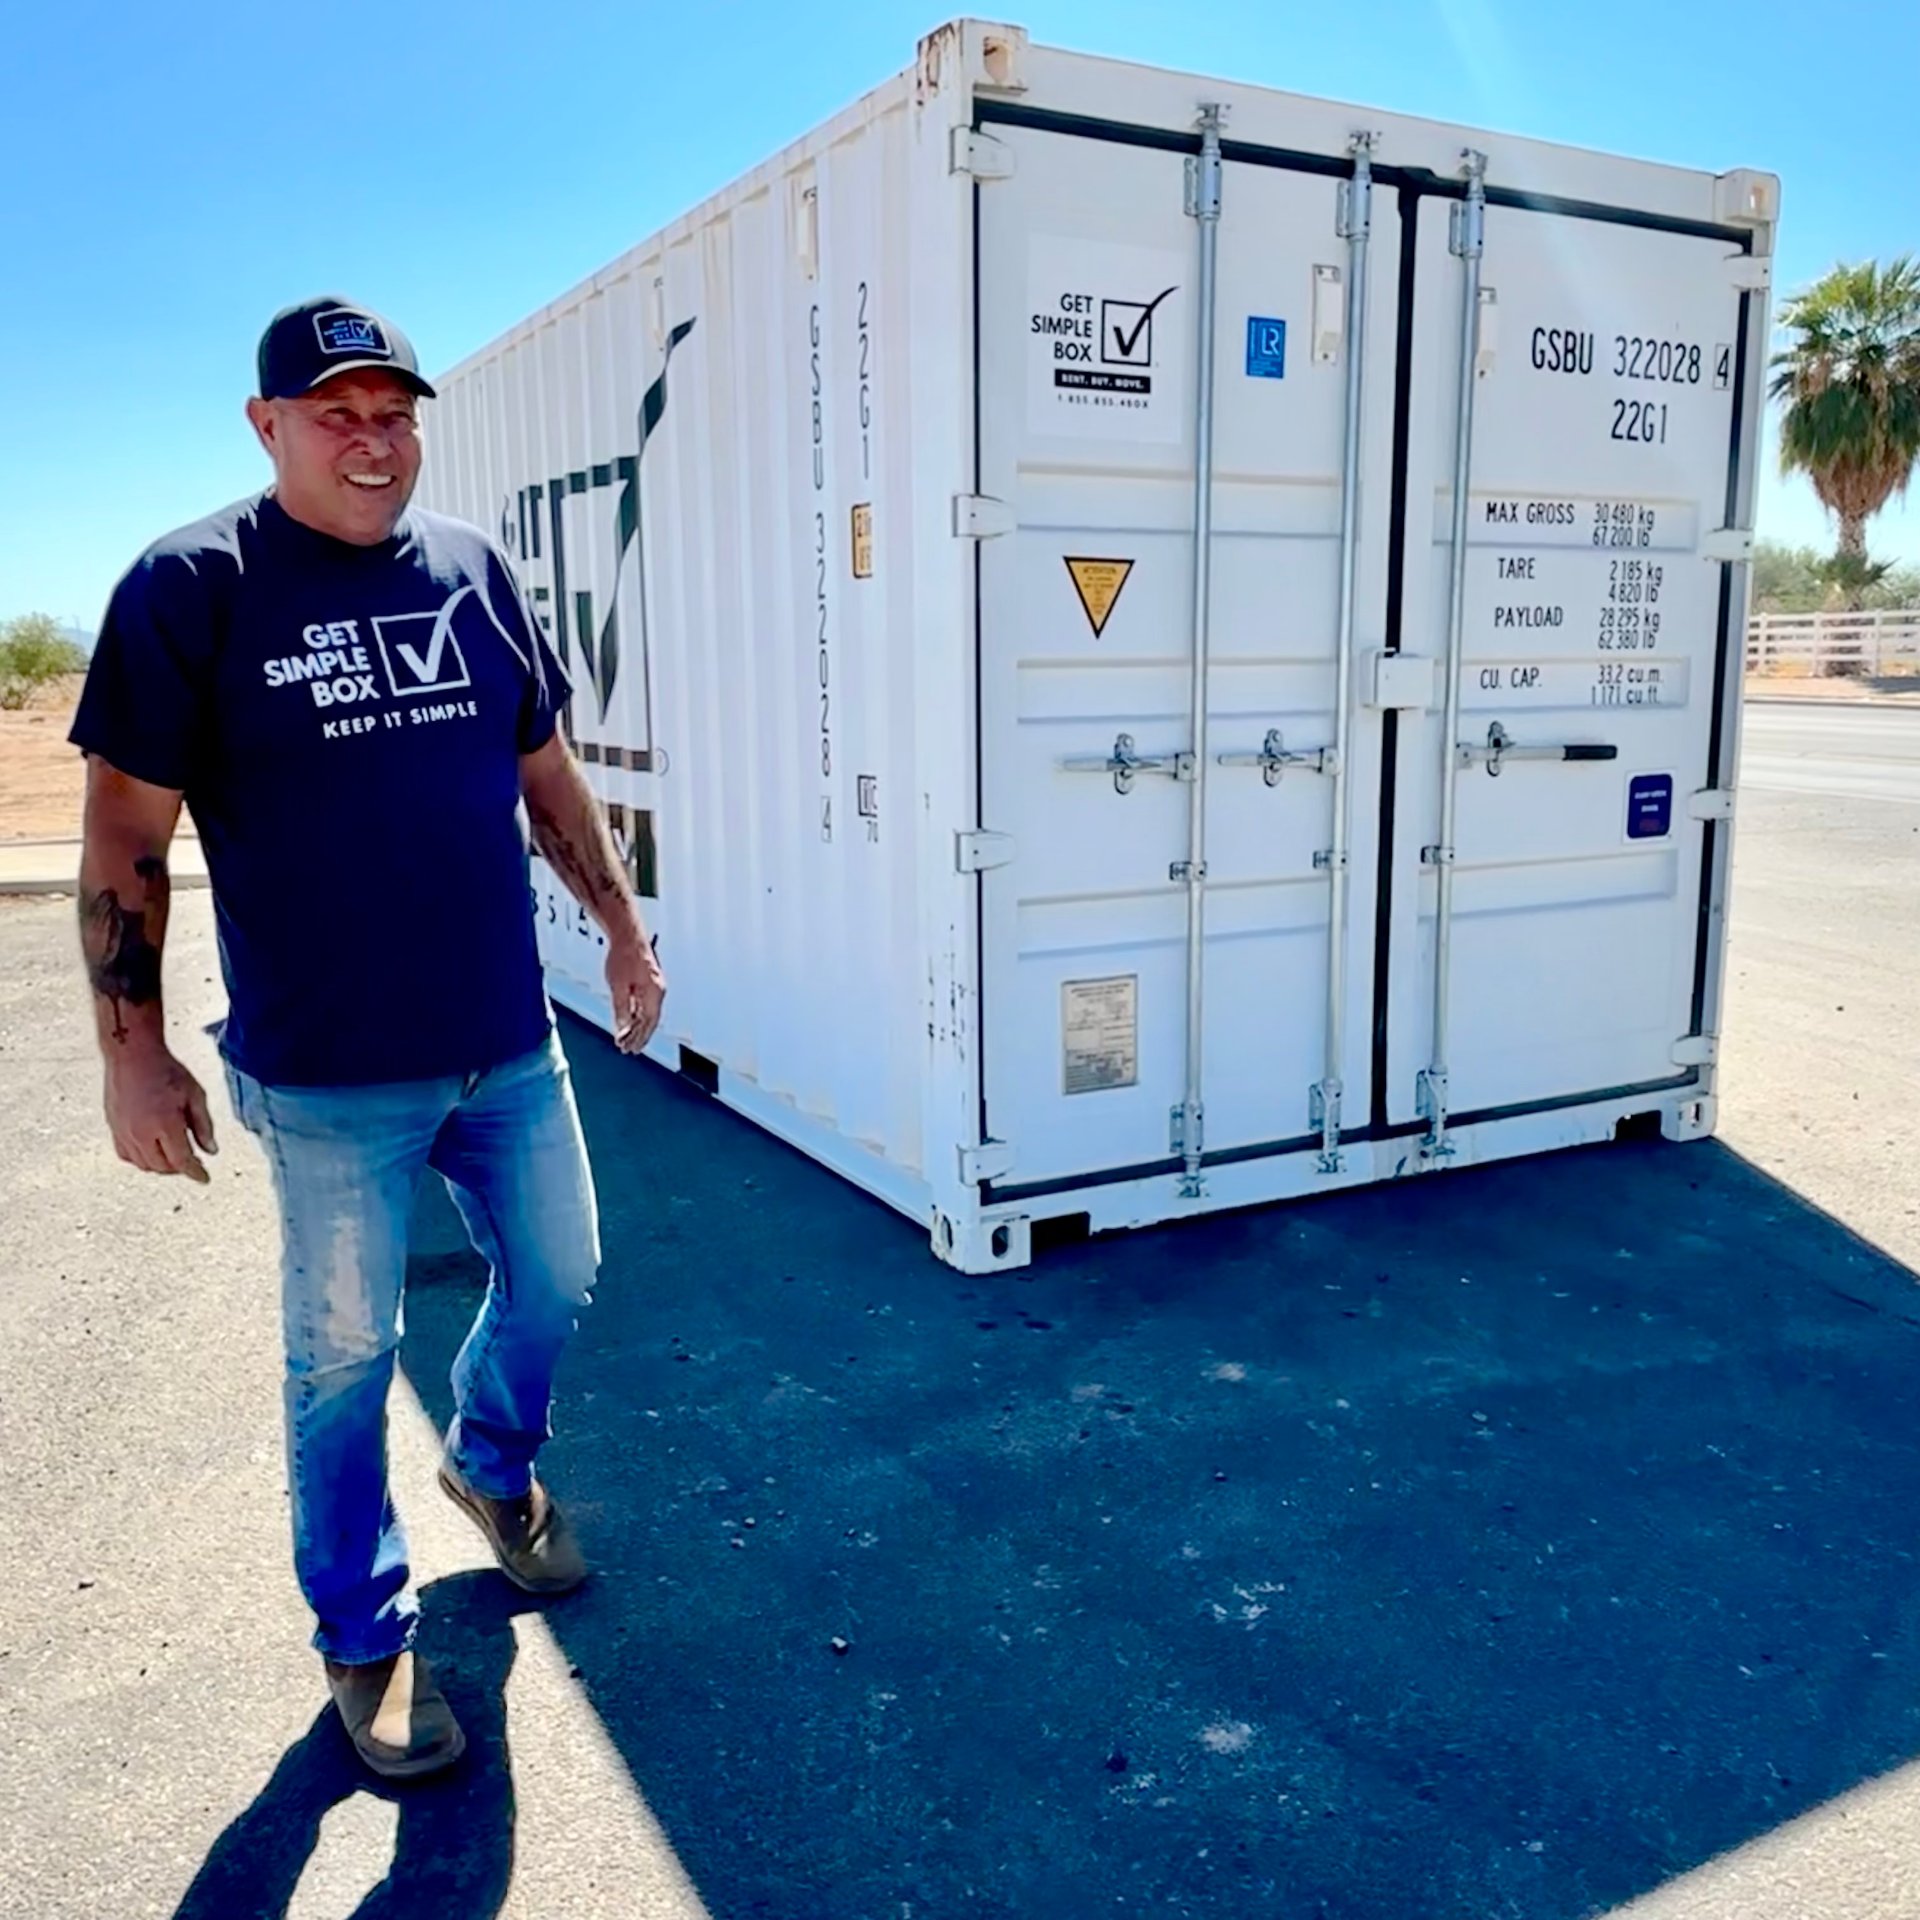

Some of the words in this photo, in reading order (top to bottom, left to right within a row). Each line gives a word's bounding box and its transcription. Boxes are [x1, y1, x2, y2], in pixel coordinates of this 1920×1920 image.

[1060, 293, 1093, 313] GET
[1031, 314, 1092, 338] SIMPLE
[1054, 341, 1092, 362] BOX
[1531, 327, 1594, 375] GSBU
[1613, 335, 1701, 384] 322028
[1716, 347, 1730, 388] 4
[810, 304, 824, 491] GSBU
[1611, 399, 1667, 444] 22G1
[1486, 501, 1518, 523] MAX
[1526, 502, 1575, 524] GROSS
[1638, 505, 1655, 531] kg
[1498, 557, 1535, 579] TARE
[1647, 560, 1663, 587] kg
[302, 619, 359, 649] GET
[1494, 606, 1563, 628] PAYLOAD
[1644, 607, 1660, 633] kg
[816, 512, 831, 777] 322028
[263, 647, 372, 687] SIMPLE
[1480, 667, 1502, 689] CU.
[1511, 667, 1542, 688] CAP.
[310, 674, 381, 708] BOX
[323, 715, 376, 739] KEEP
[384, 711, 402, 728] IT
[410, 700, 478, 724] SIMPLE
